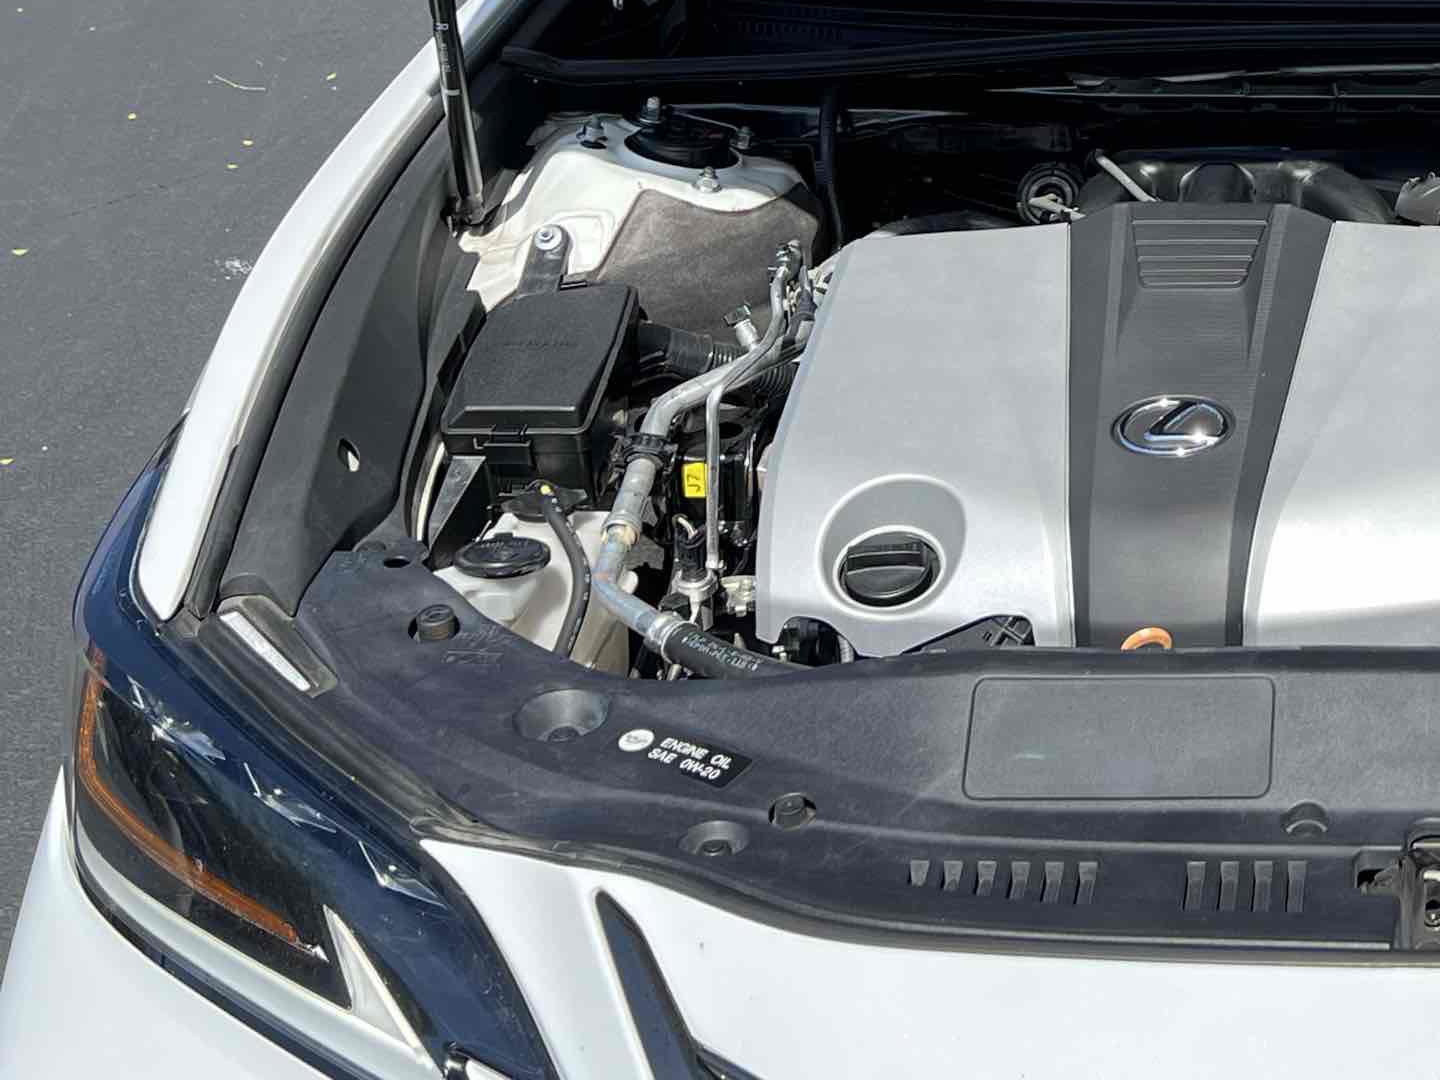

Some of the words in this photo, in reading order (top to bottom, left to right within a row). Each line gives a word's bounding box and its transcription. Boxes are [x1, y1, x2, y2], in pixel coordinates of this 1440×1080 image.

[647, 748, 678, 764] SAE
[660, 737, 709, 760] ENGINE
[710, 754, 732, 770] OIL
